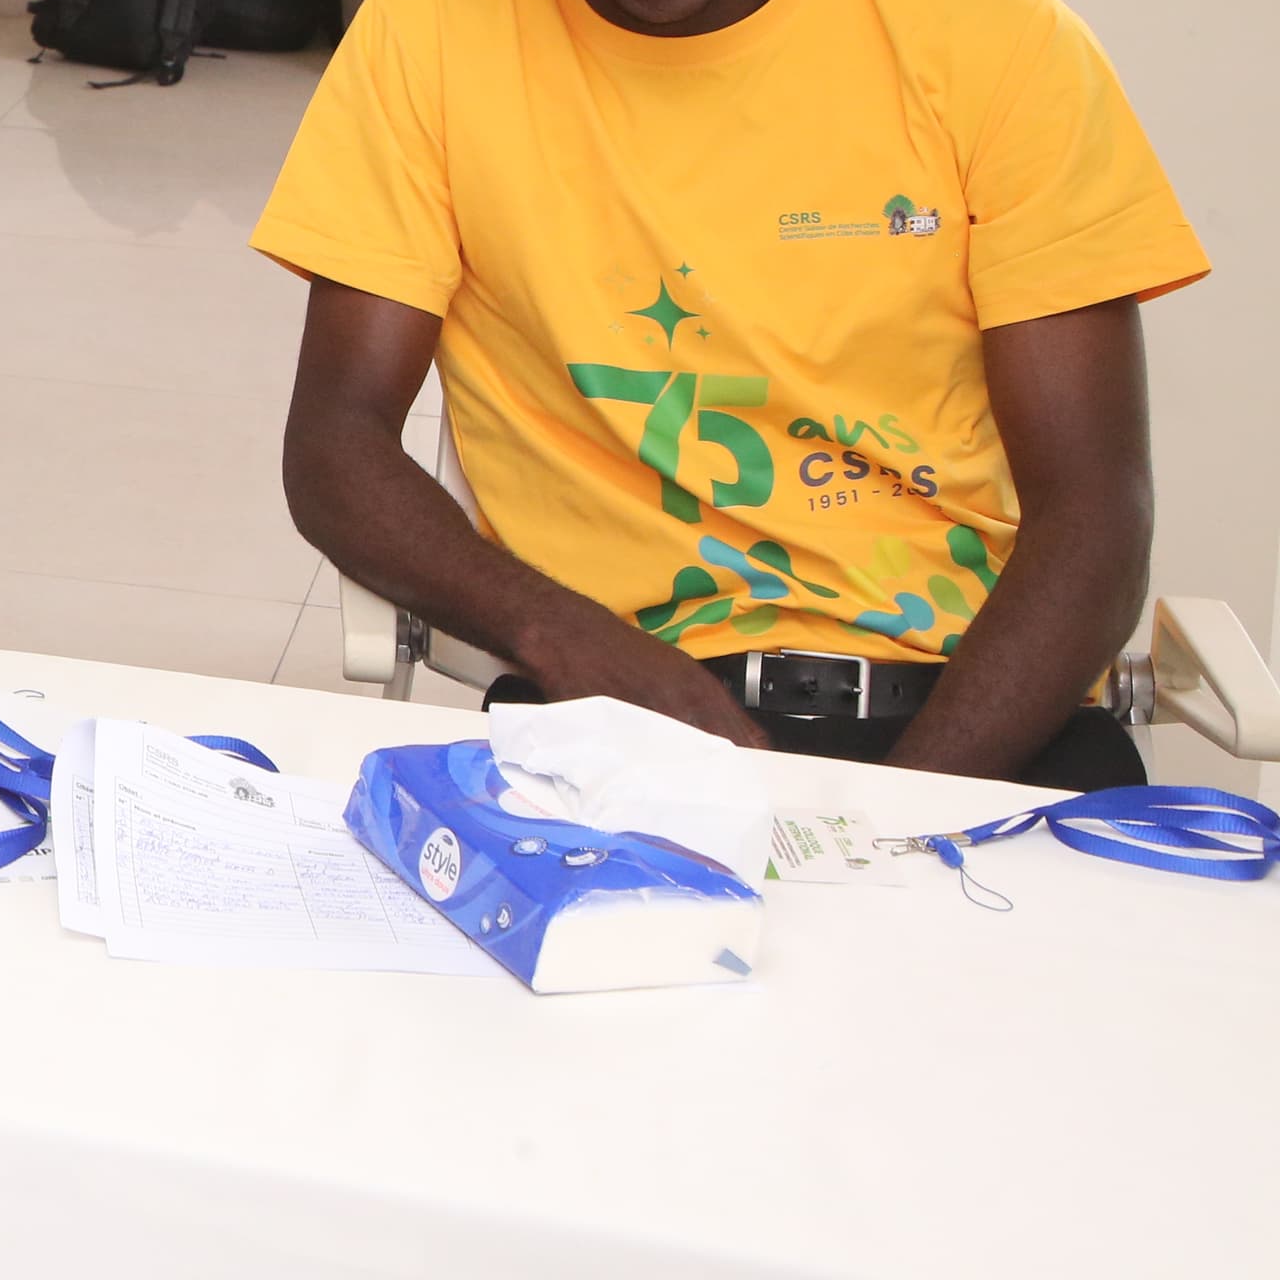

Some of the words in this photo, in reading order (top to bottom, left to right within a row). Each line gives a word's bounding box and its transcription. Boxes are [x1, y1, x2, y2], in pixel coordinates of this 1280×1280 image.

[779, 211, 821, 226] CSRS
[566, 363, 774, 523] 75
[787, 414, 920, 454] ans
[808, 489, 858, 511] 1951
[423, 841, 458, 882] style
